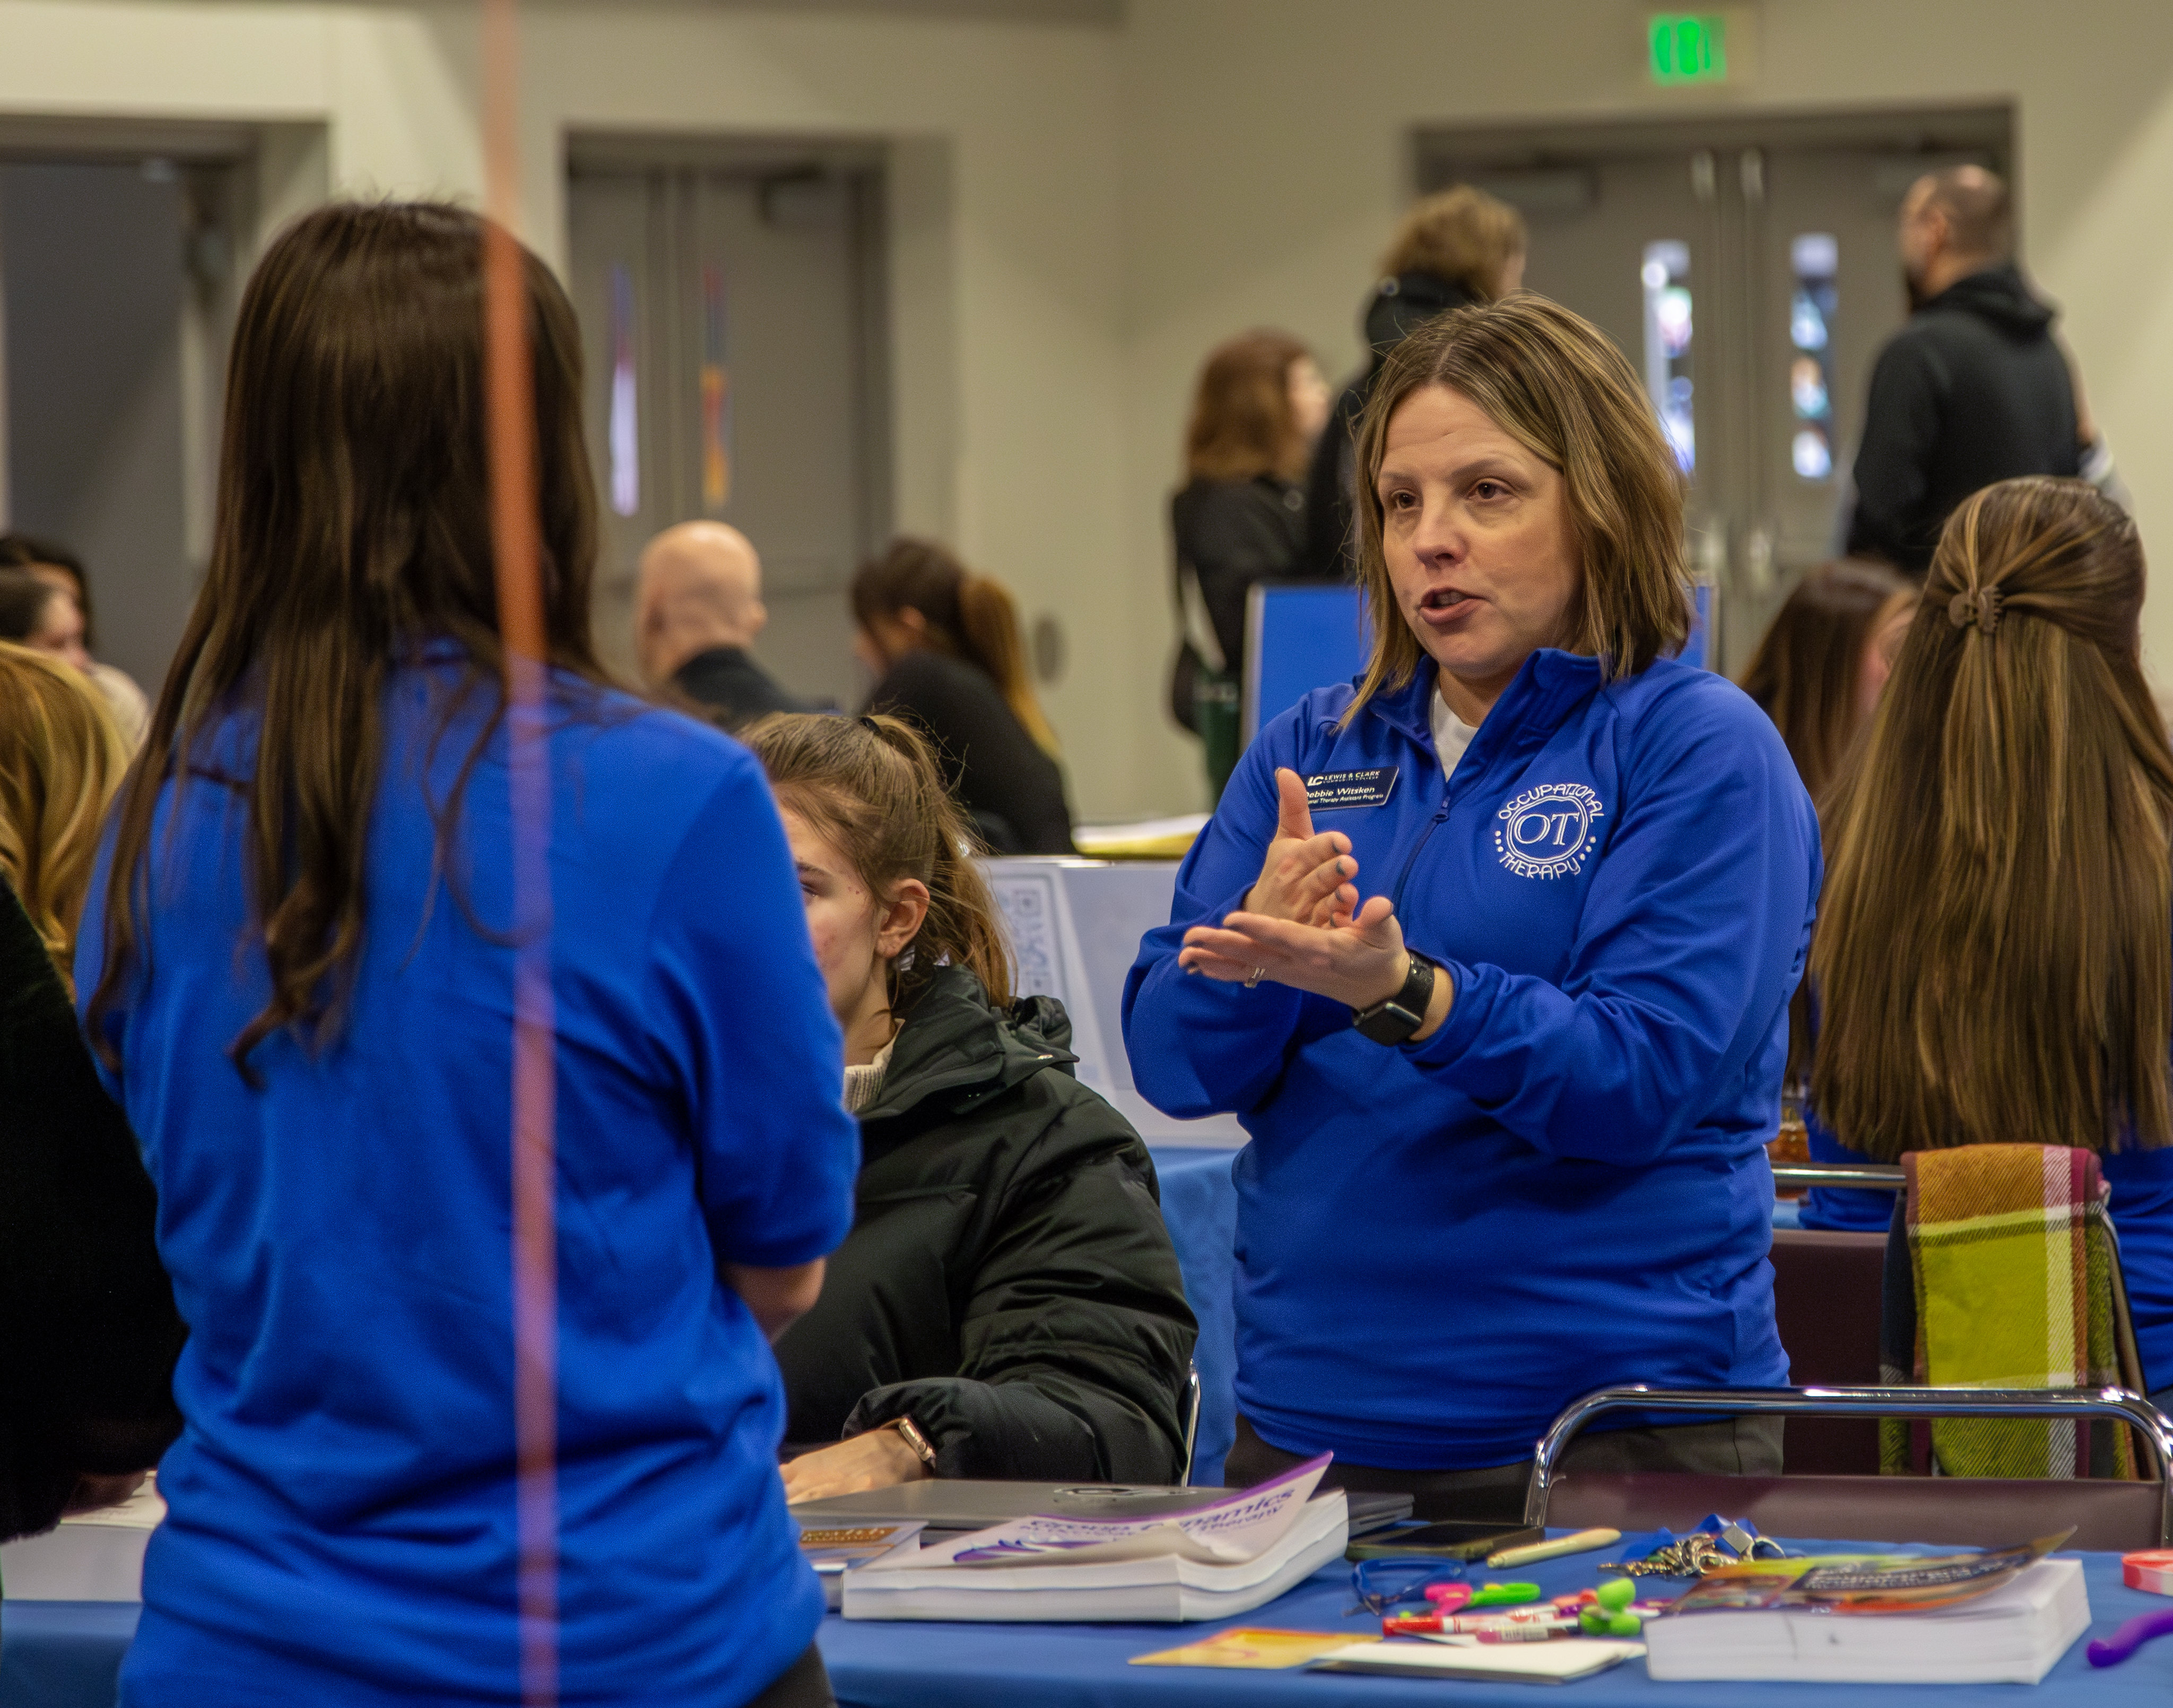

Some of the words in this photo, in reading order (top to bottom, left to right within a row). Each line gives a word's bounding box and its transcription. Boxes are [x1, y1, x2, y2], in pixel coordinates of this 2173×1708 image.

[1307, 776, 1324, 786] LC
[1498, 783, 1605, 823] OCCUPATIONAL
[1514, 812, 1580, 846] OT
[1499, 851, 1581, 880] THERAPY
[1141, 1489, 1296, 1531] namics
